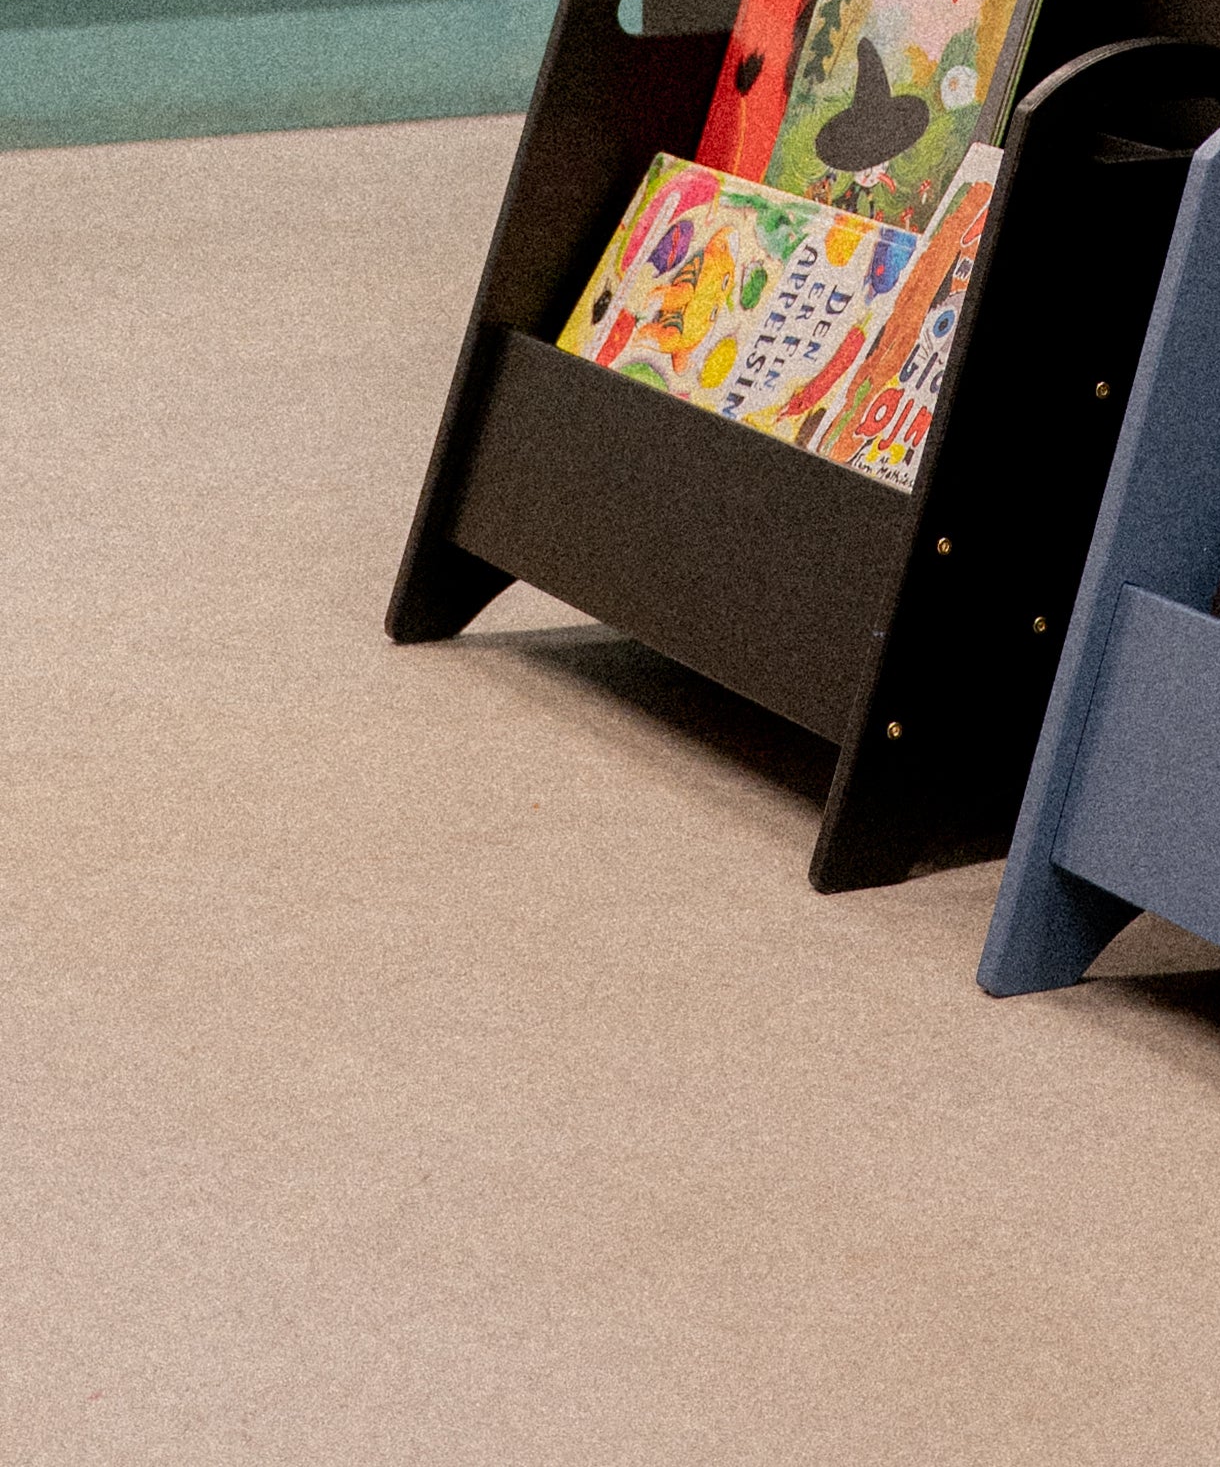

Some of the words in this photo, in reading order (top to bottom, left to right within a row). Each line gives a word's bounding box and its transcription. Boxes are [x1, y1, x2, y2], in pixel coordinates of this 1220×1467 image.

[722, 244, 818, 421] APPELSIN
[796, 282, 826, 321] ER
[803, 284, 853, 363] DEN
[766, 335, 801, 391] FIN
